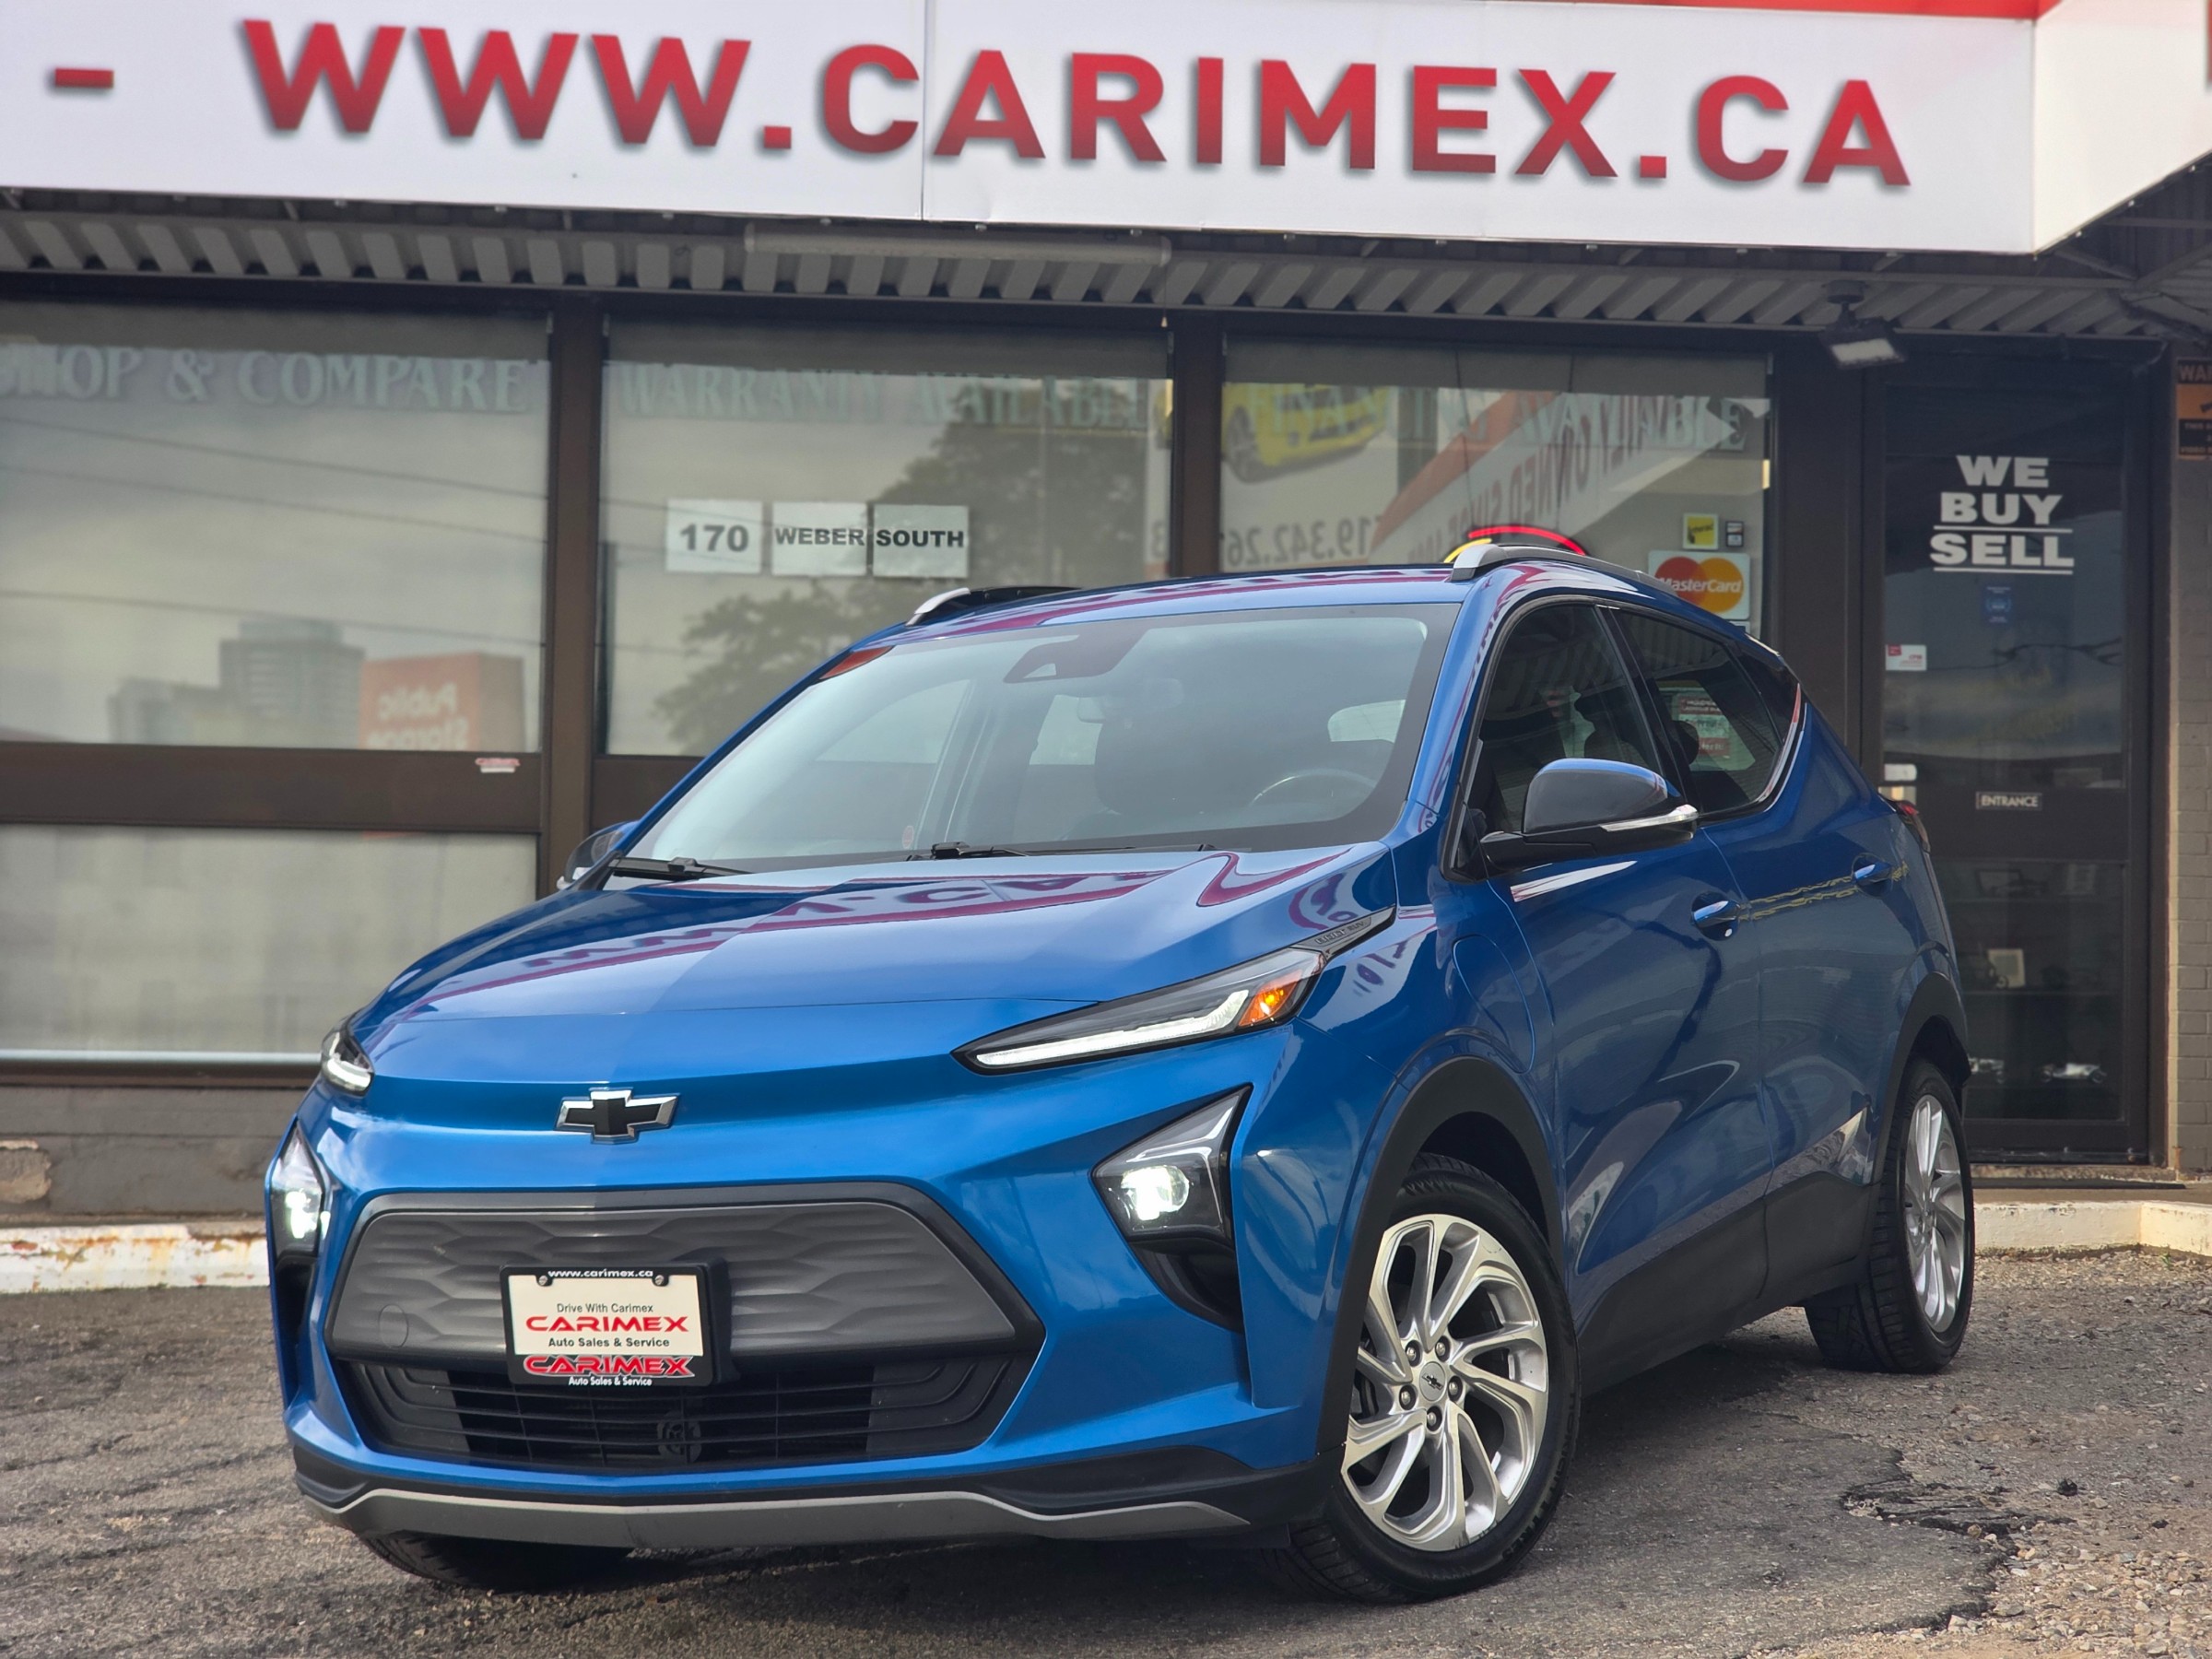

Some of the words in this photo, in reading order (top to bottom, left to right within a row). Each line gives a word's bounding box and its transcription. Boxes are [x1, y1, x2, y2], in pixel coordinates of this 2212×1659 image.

[243, 19, 1912, 187] WWW.CARIMEX.CA
[168, 348, 212, 402] &
[237, 351, 528, 412] COMPARE
[1956, 455, 2049, 488] WE
[1940, 492, 2063, 525] BUY
[679, 524, 749, 552] 170
[775, 528, 865, 546] WEBER
[876, 529, 964, 547] SOUTH
[1930, 533, 2074, 567] SELL
[1981, 795, 2039, 807] ENTRANCE
[547, 1268, 653, 1278] www.carimex.ca
[557, 1303, 582, 1313] Drive
[585, 1303, 608, 1313] With
[611, 1303, 653, 1313] Carimex
[525, 1316, 688, 1332] CARIMEX
[548, 1337, 575, 1347] Auto
[578, 1337, 610, 1347] Sales
[613, 1338, 622, 1347] &
[626, 1337, 670, 1347] Service
[524, 1355, 694, 1376] CARIMEX
[569, 1376, 589, 1386] Auto
[590, 1376, 612, 1386] Sales
[614, 1377, 622, 1386] &
[623, 1376, 653, 1386] Service
